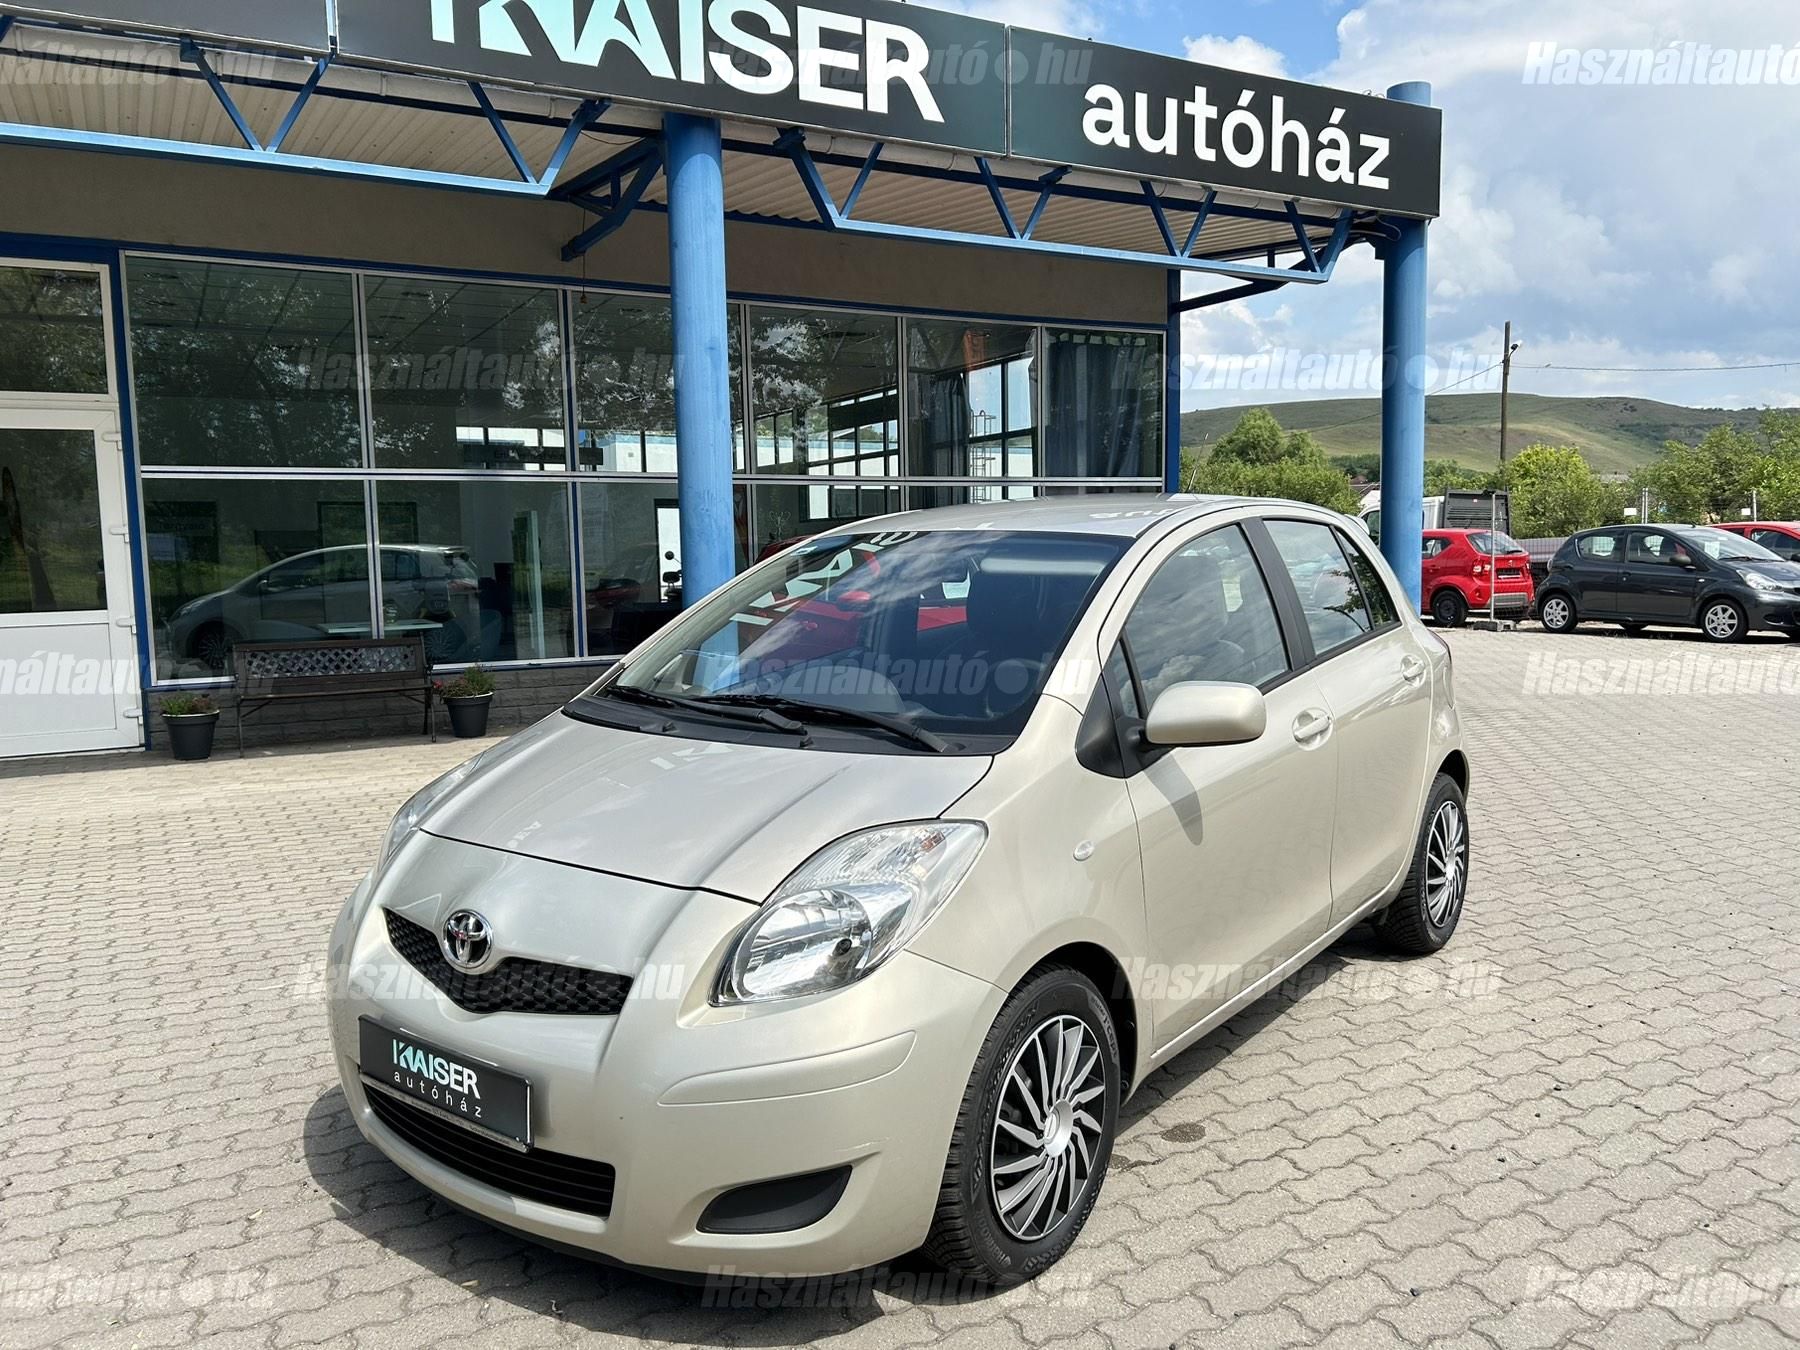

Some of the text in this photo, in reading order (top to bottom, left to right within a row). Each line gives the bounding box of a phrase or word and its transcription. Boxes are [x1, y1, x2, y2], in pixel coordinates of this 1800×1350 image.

[1082, 83, 1390, 190] autóház
[393, 1039, 480, 1099] KAISER
[394, 1071, 481, 1118] autóház
